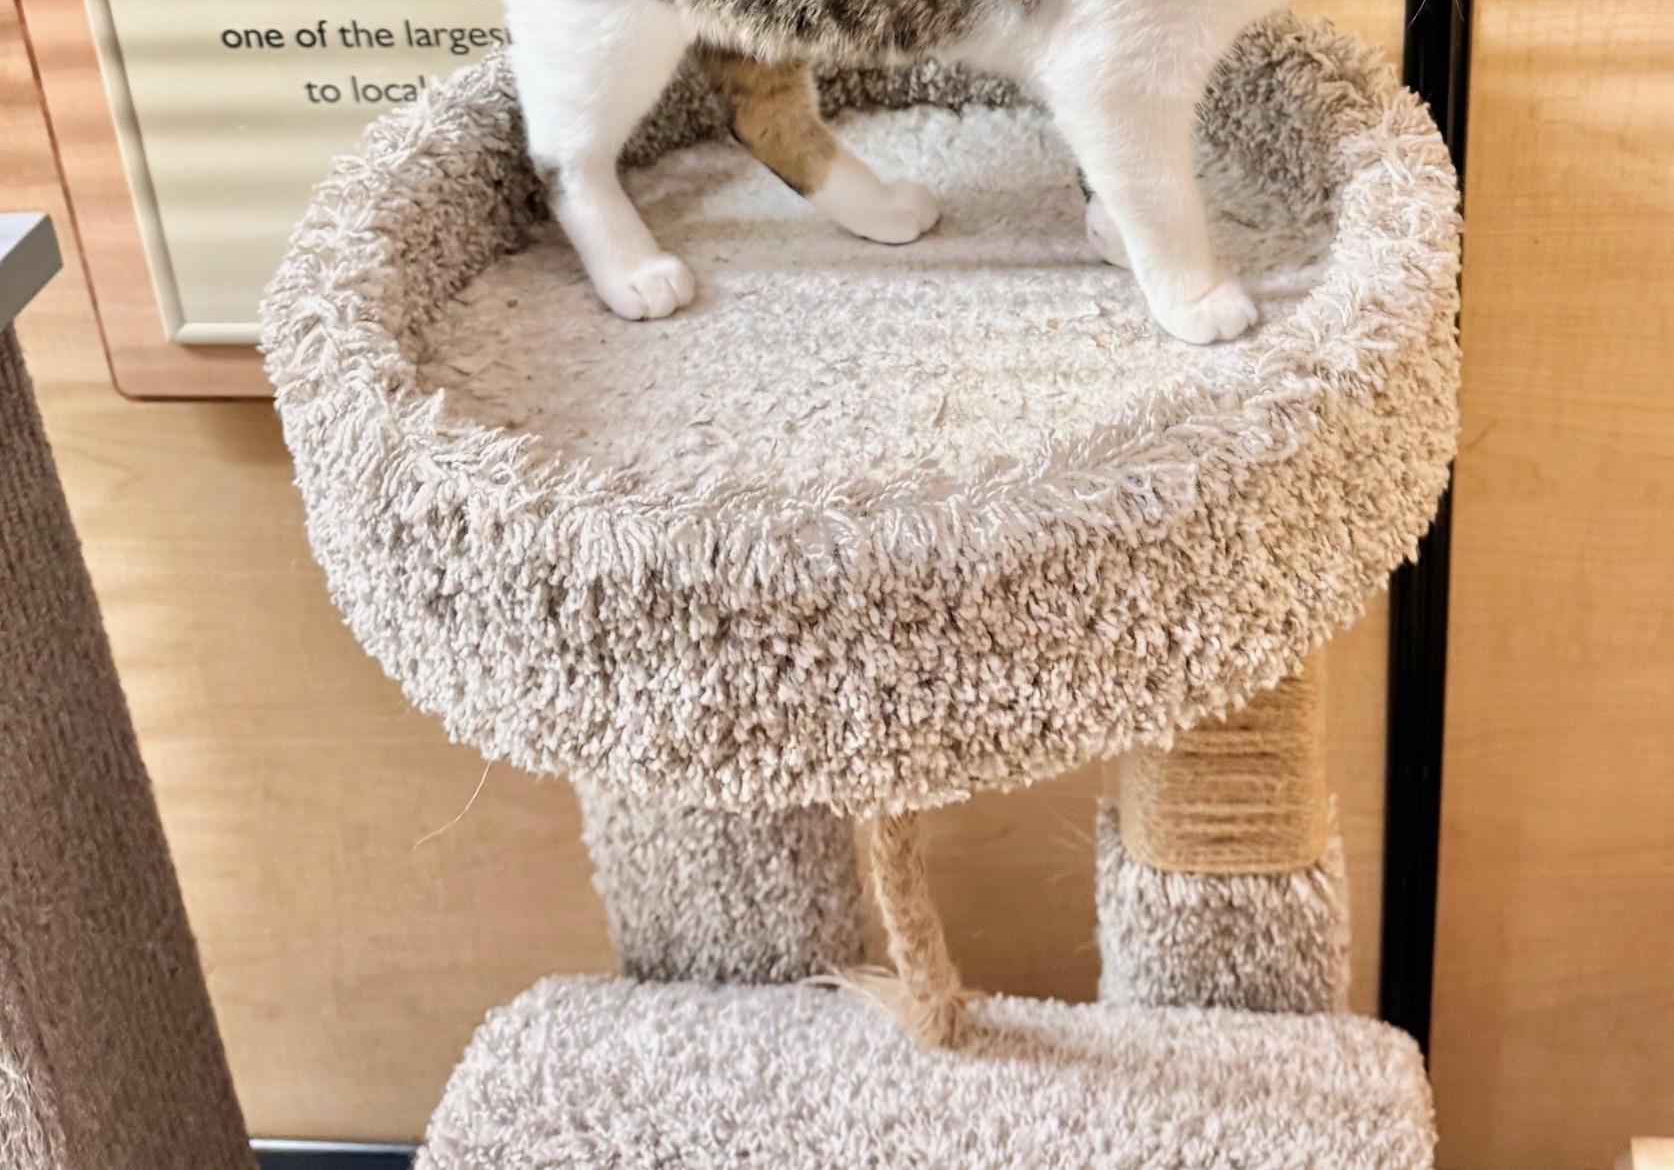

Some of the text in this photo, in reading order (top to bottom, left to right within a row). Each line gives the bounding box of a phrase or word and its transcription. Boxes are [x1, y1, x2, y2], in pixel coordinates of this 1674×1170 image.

[220, 28, 286, 50] one
[294, 19, 328, 49] of
[337, 20, 395, 49] the
[304, 82, 342, 104] to
